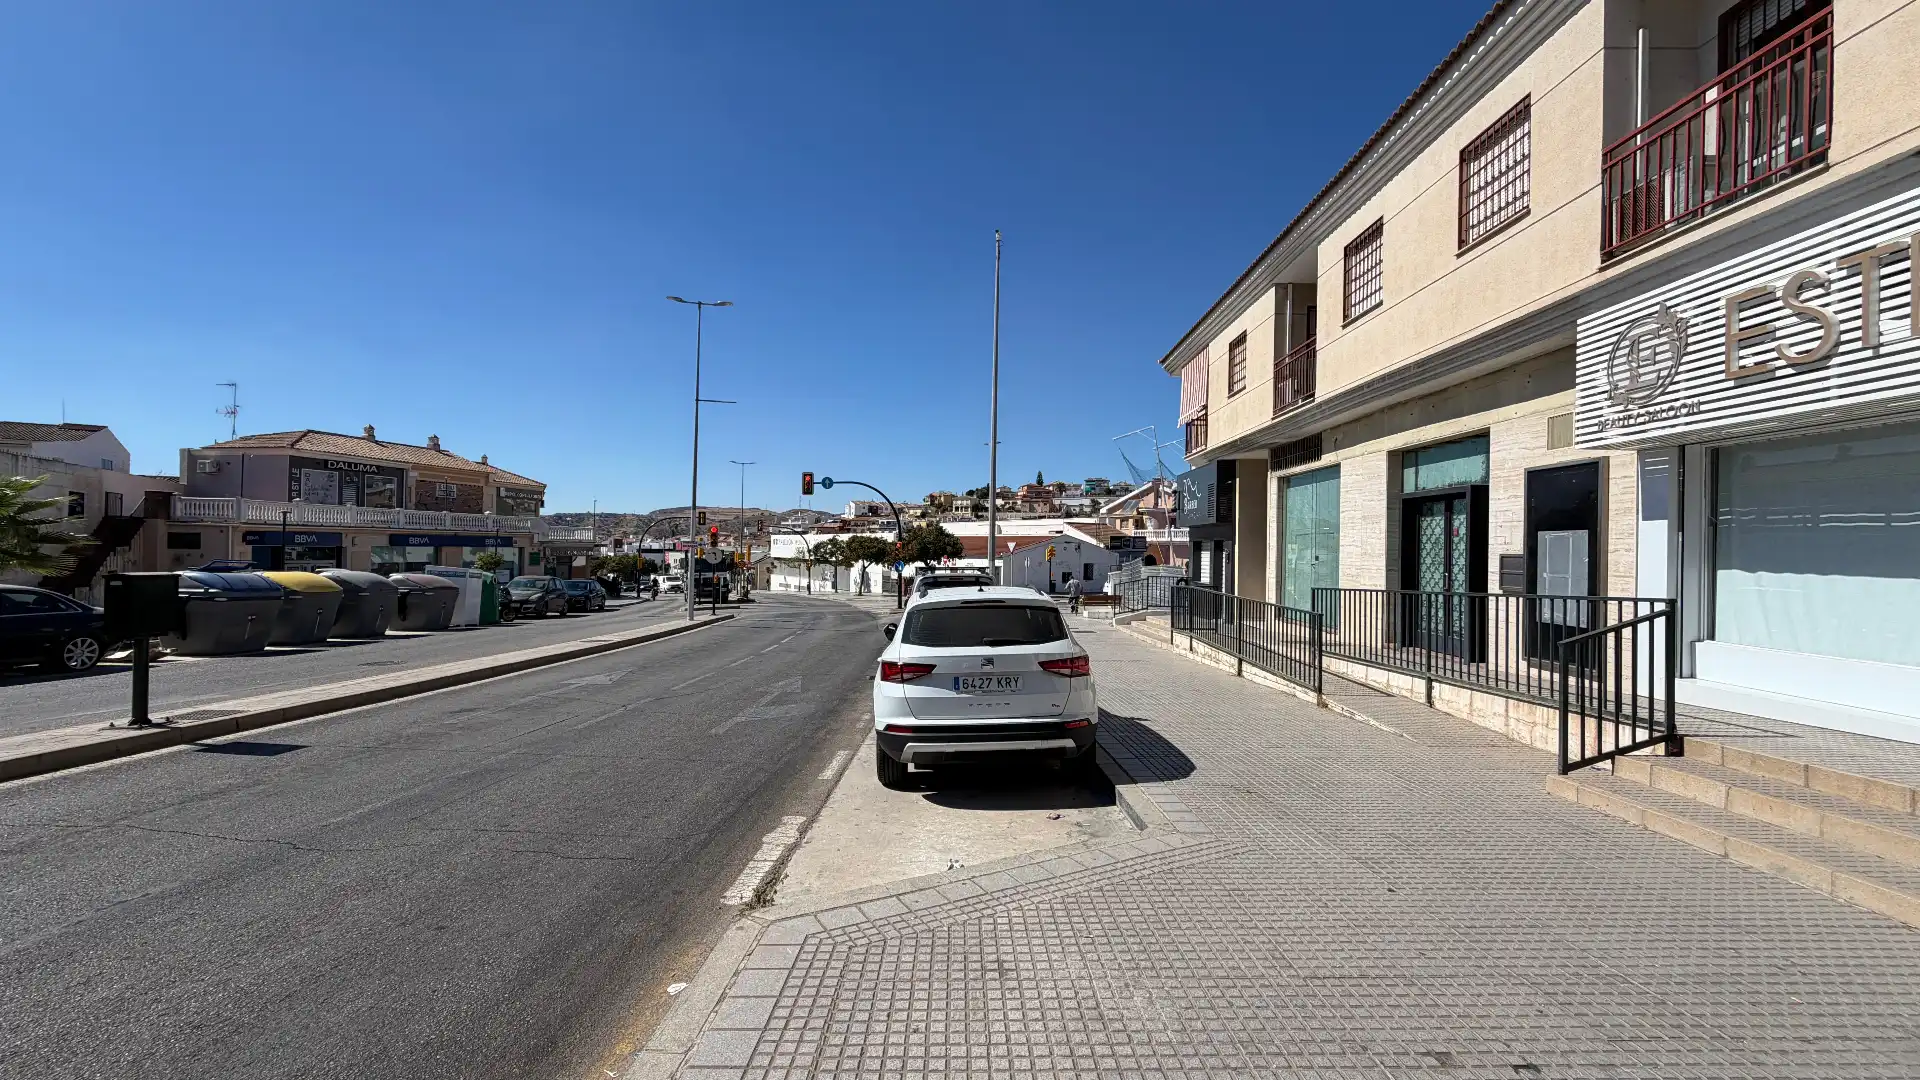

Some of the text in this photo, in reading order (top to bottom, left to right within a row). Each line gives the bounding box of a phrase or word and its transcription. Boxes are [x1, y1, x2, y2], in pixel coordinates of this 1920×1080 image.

[1644, 399, 1701, 423] SALOON
[327, 460, 378, 473] DALUMA
[294, 534, 318, 543] BBVA
[408, 536, 430, 545] BBVA
[962, 676, 1020, 690] 6427 KRY
